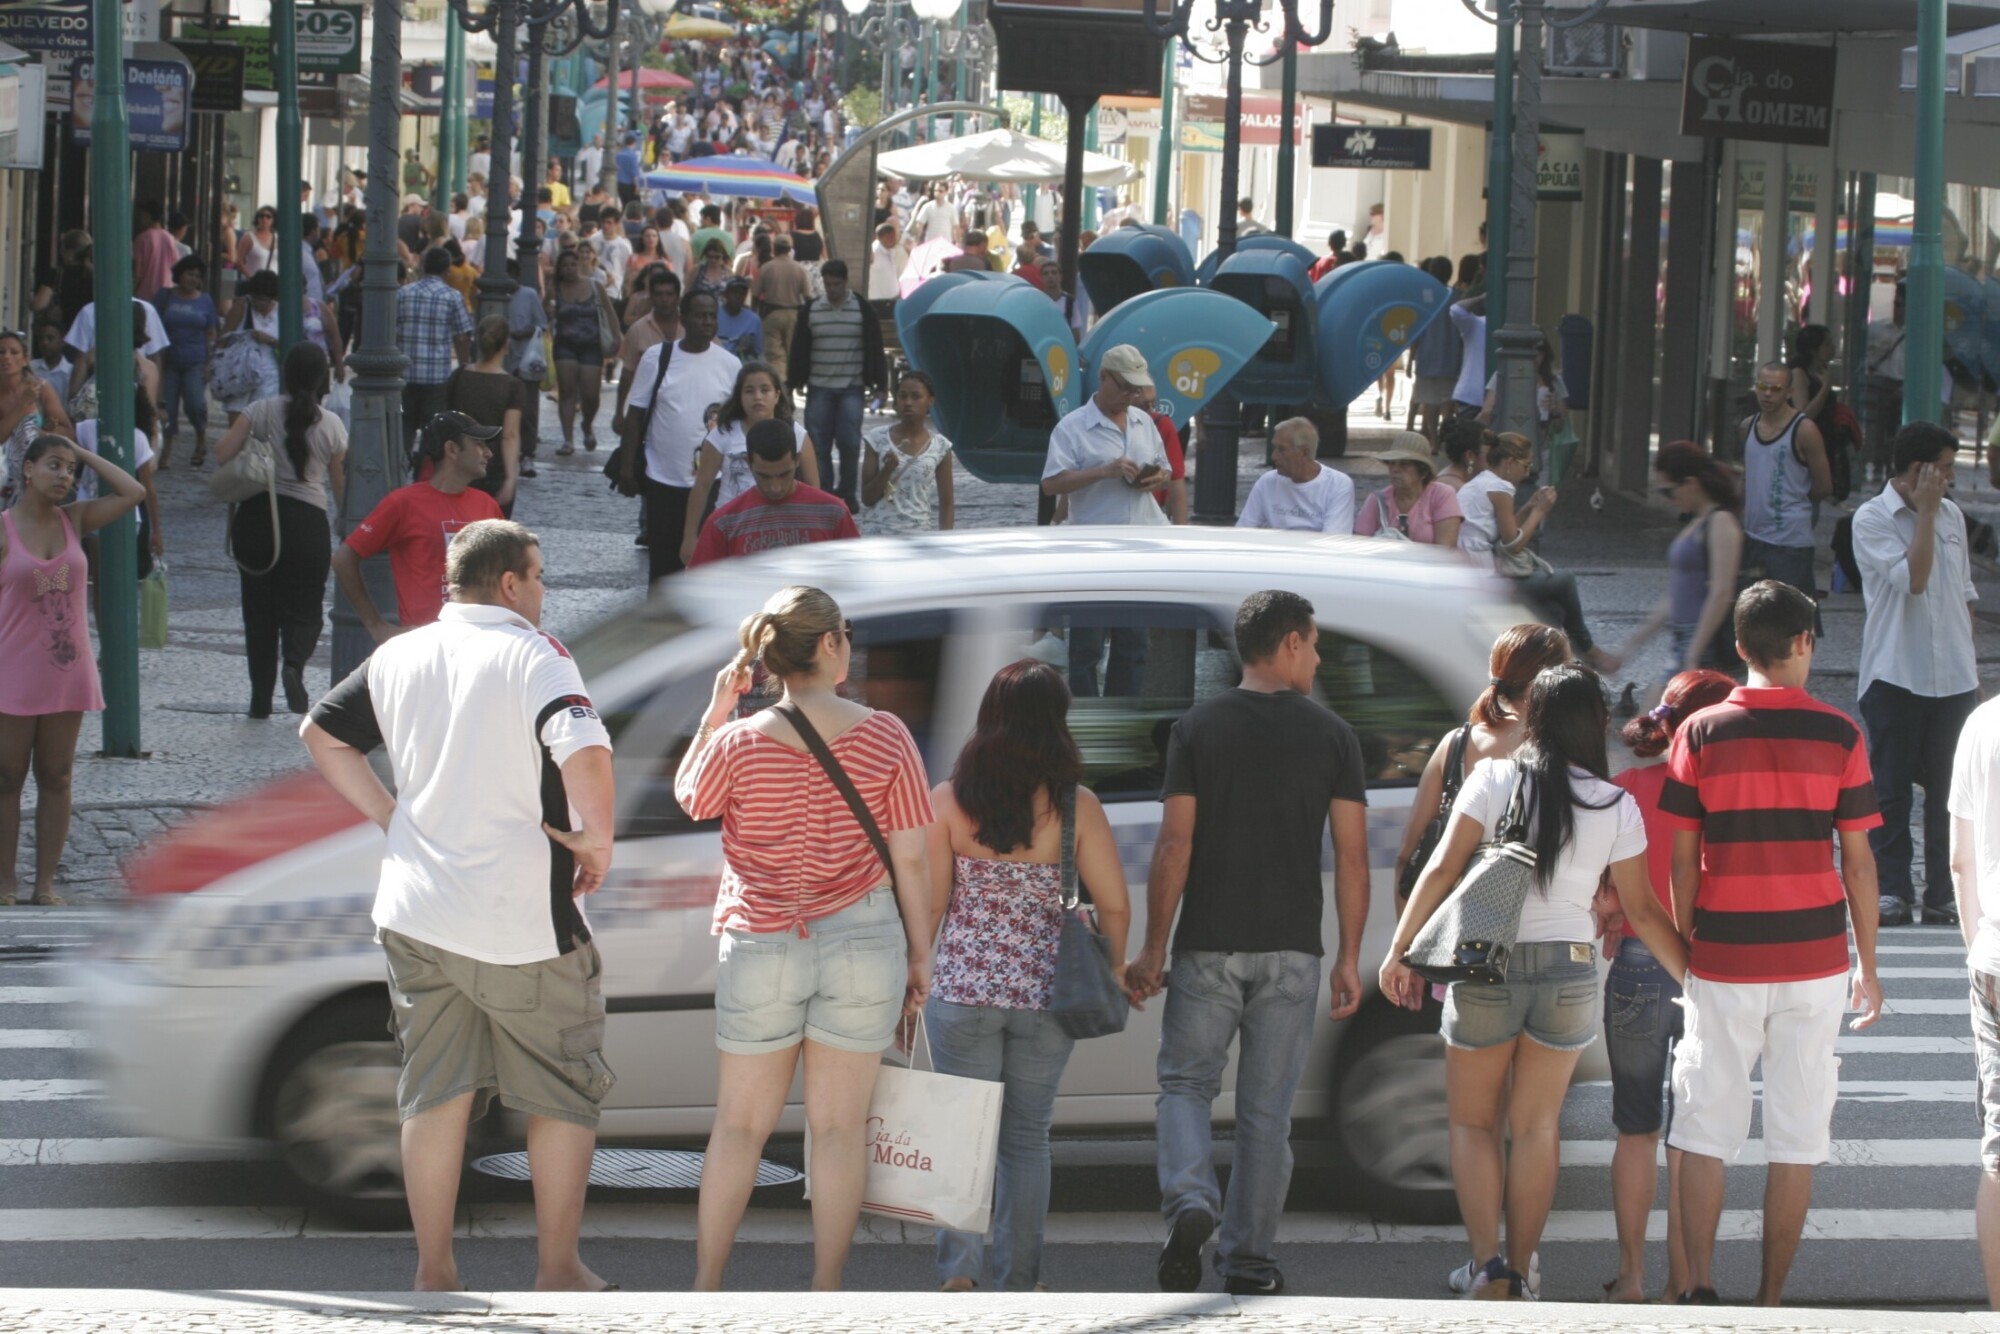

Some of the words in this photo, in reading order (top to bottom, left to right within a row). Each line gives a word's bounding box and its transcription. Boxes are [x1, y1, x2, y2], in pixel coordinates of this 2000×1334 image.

[0, 15, 88, 30] QUEVEDO
[128, 66, 182, 86] Dentária
[1766, 69, 1793, 90] do
[1701, 85, 1827, 129] HOMEM
[1240, 113, 1303, 129] PALAZO
[1537, 173, 1580, 187] OPULAR
[1389, 323, 1406, 342] oi
[1053, 369, 1064, 391] oi
[1176, 371, 1199, 393] oi
[873, 1143, 933, 1172] Moda
